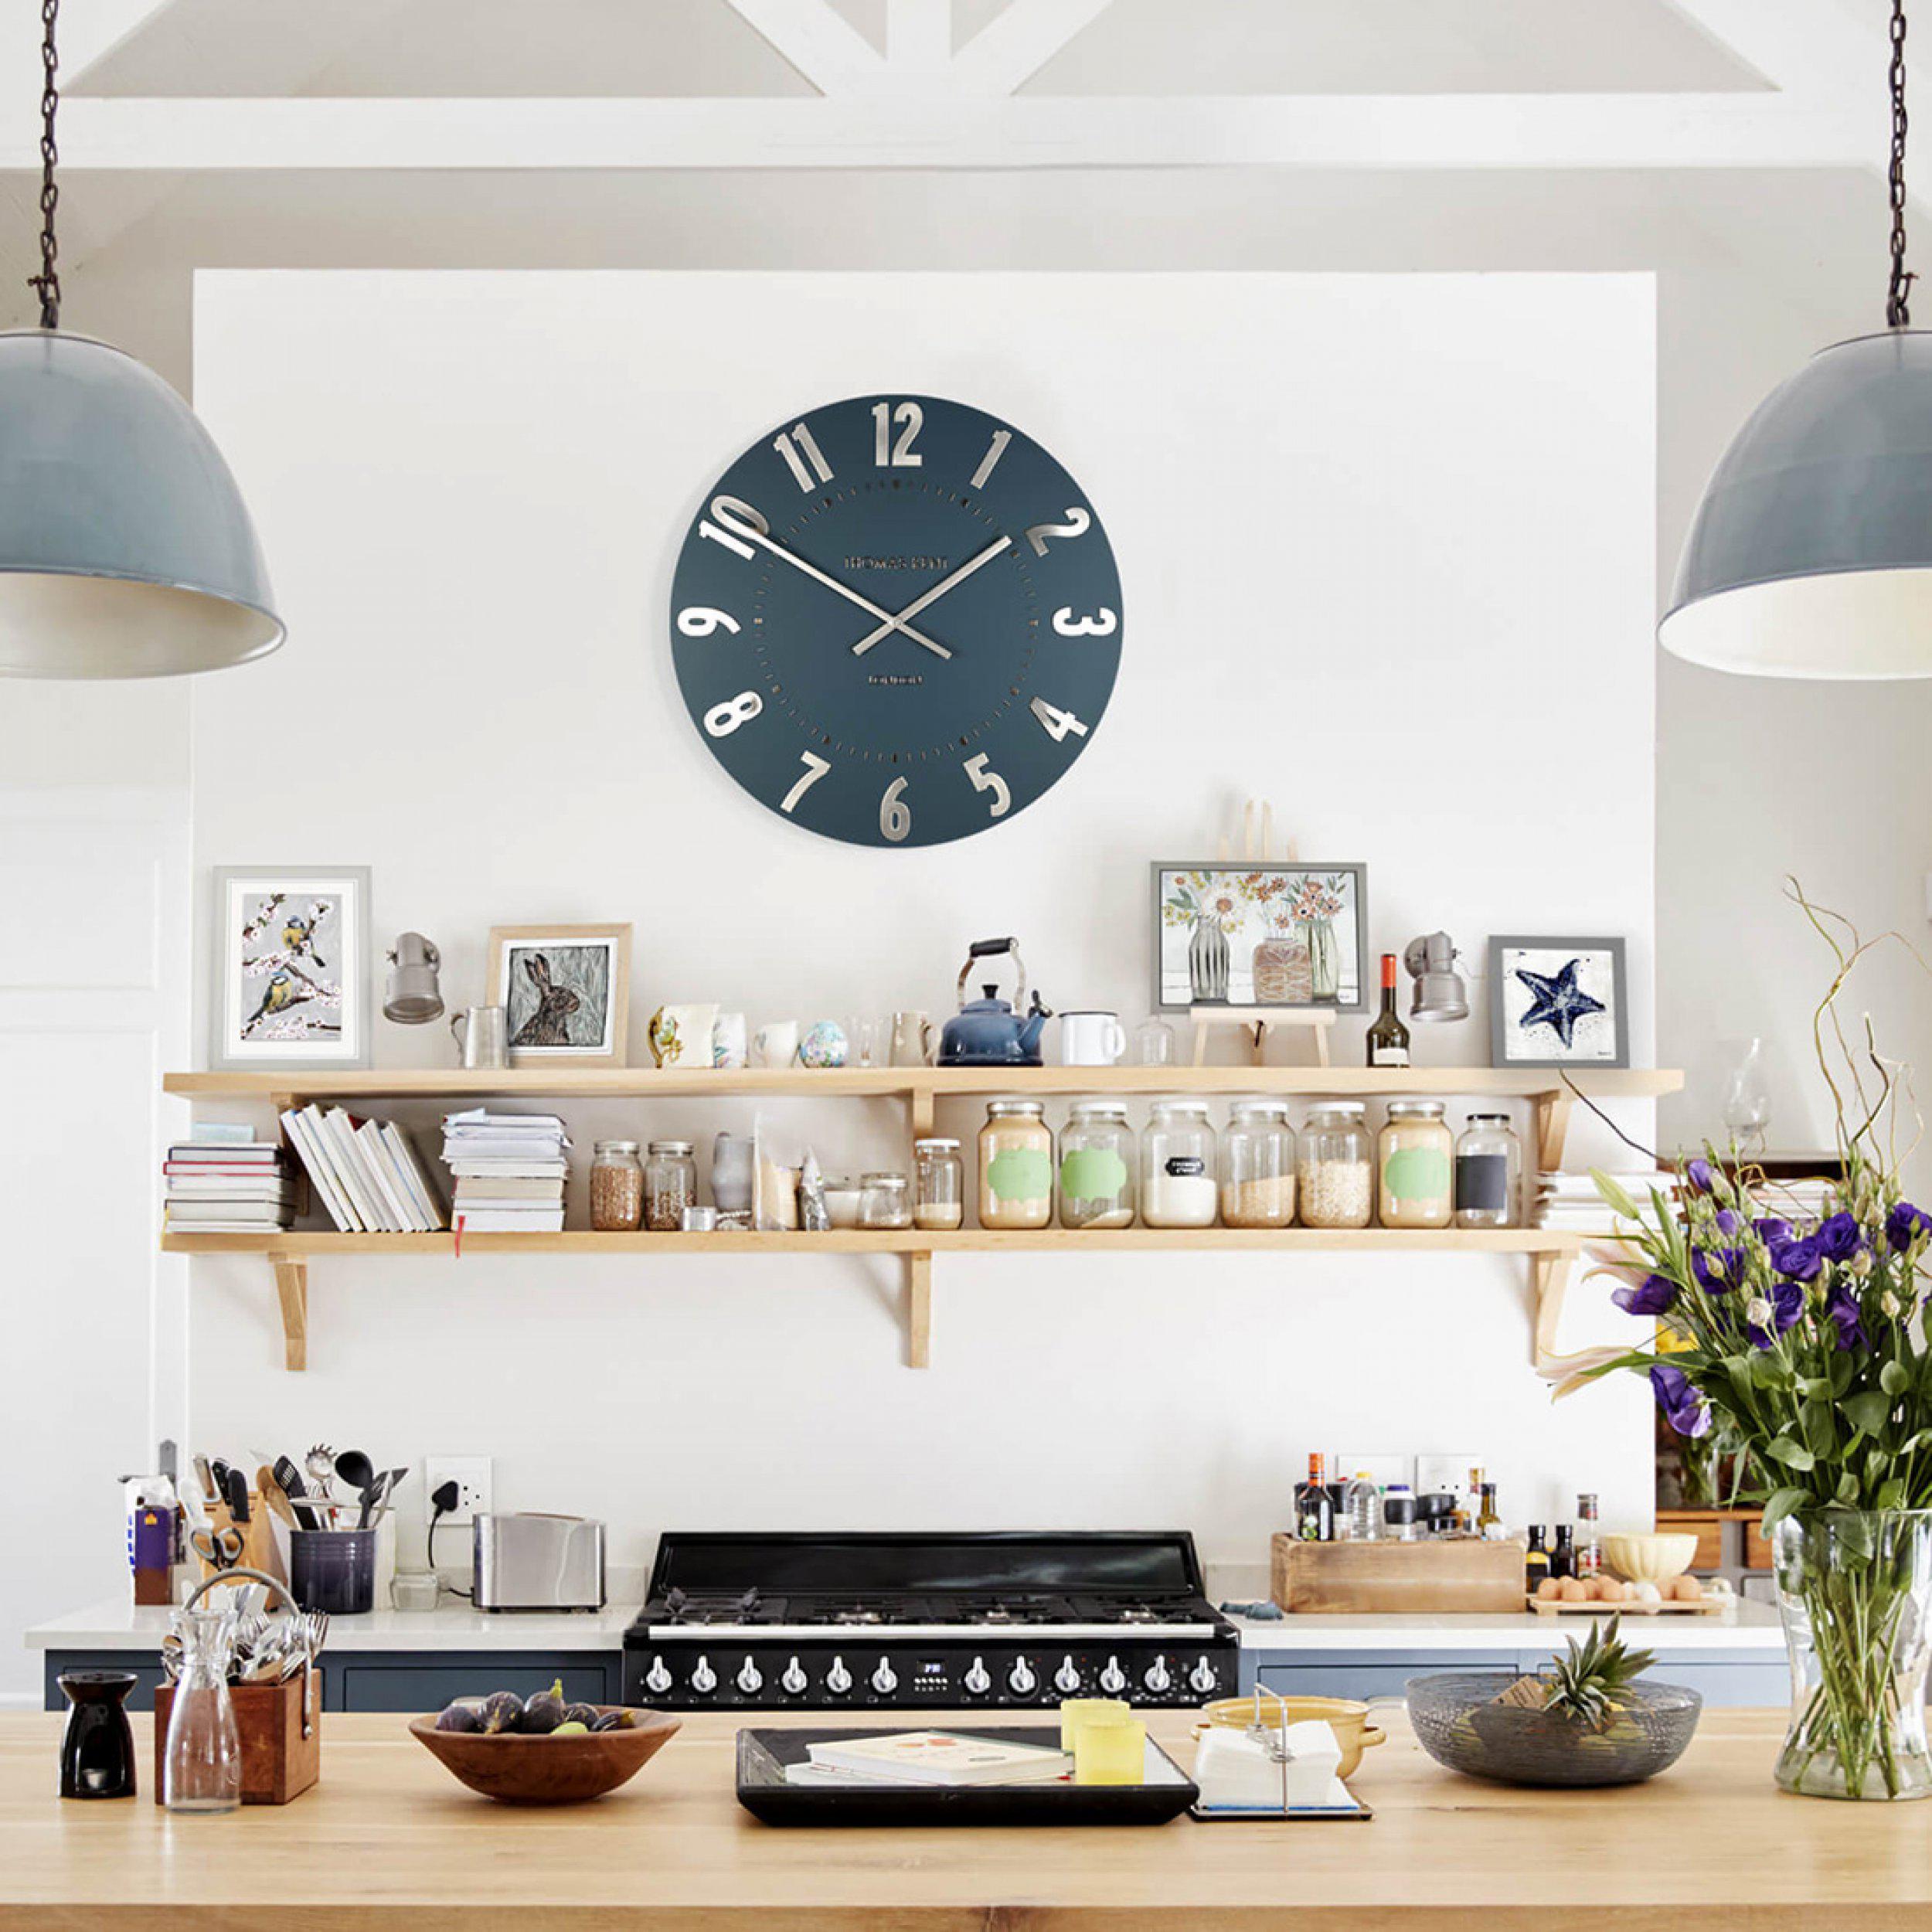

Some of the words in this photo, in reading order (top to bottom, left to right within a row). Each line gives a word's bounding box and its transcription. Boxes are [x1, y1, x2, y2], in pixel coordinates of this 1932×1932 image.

[774, 423, 835, 493] 11
[872, 402, 923, 467] 12
[970, 430, 1012, 490] 1
[699, 495, 770, 560] 10
[1026, 507, 1090, 556] 2
[677, 606, 741, 638] 9
[1052, 606, 1117, 637] 3
[703, 691, 764, 738] 8
[1029, 696, 1088, 743] 4
[781, 750, 832, 814] 7
[879, 776, 911, 842] 6
[964, 752, 1011, 817] 5
